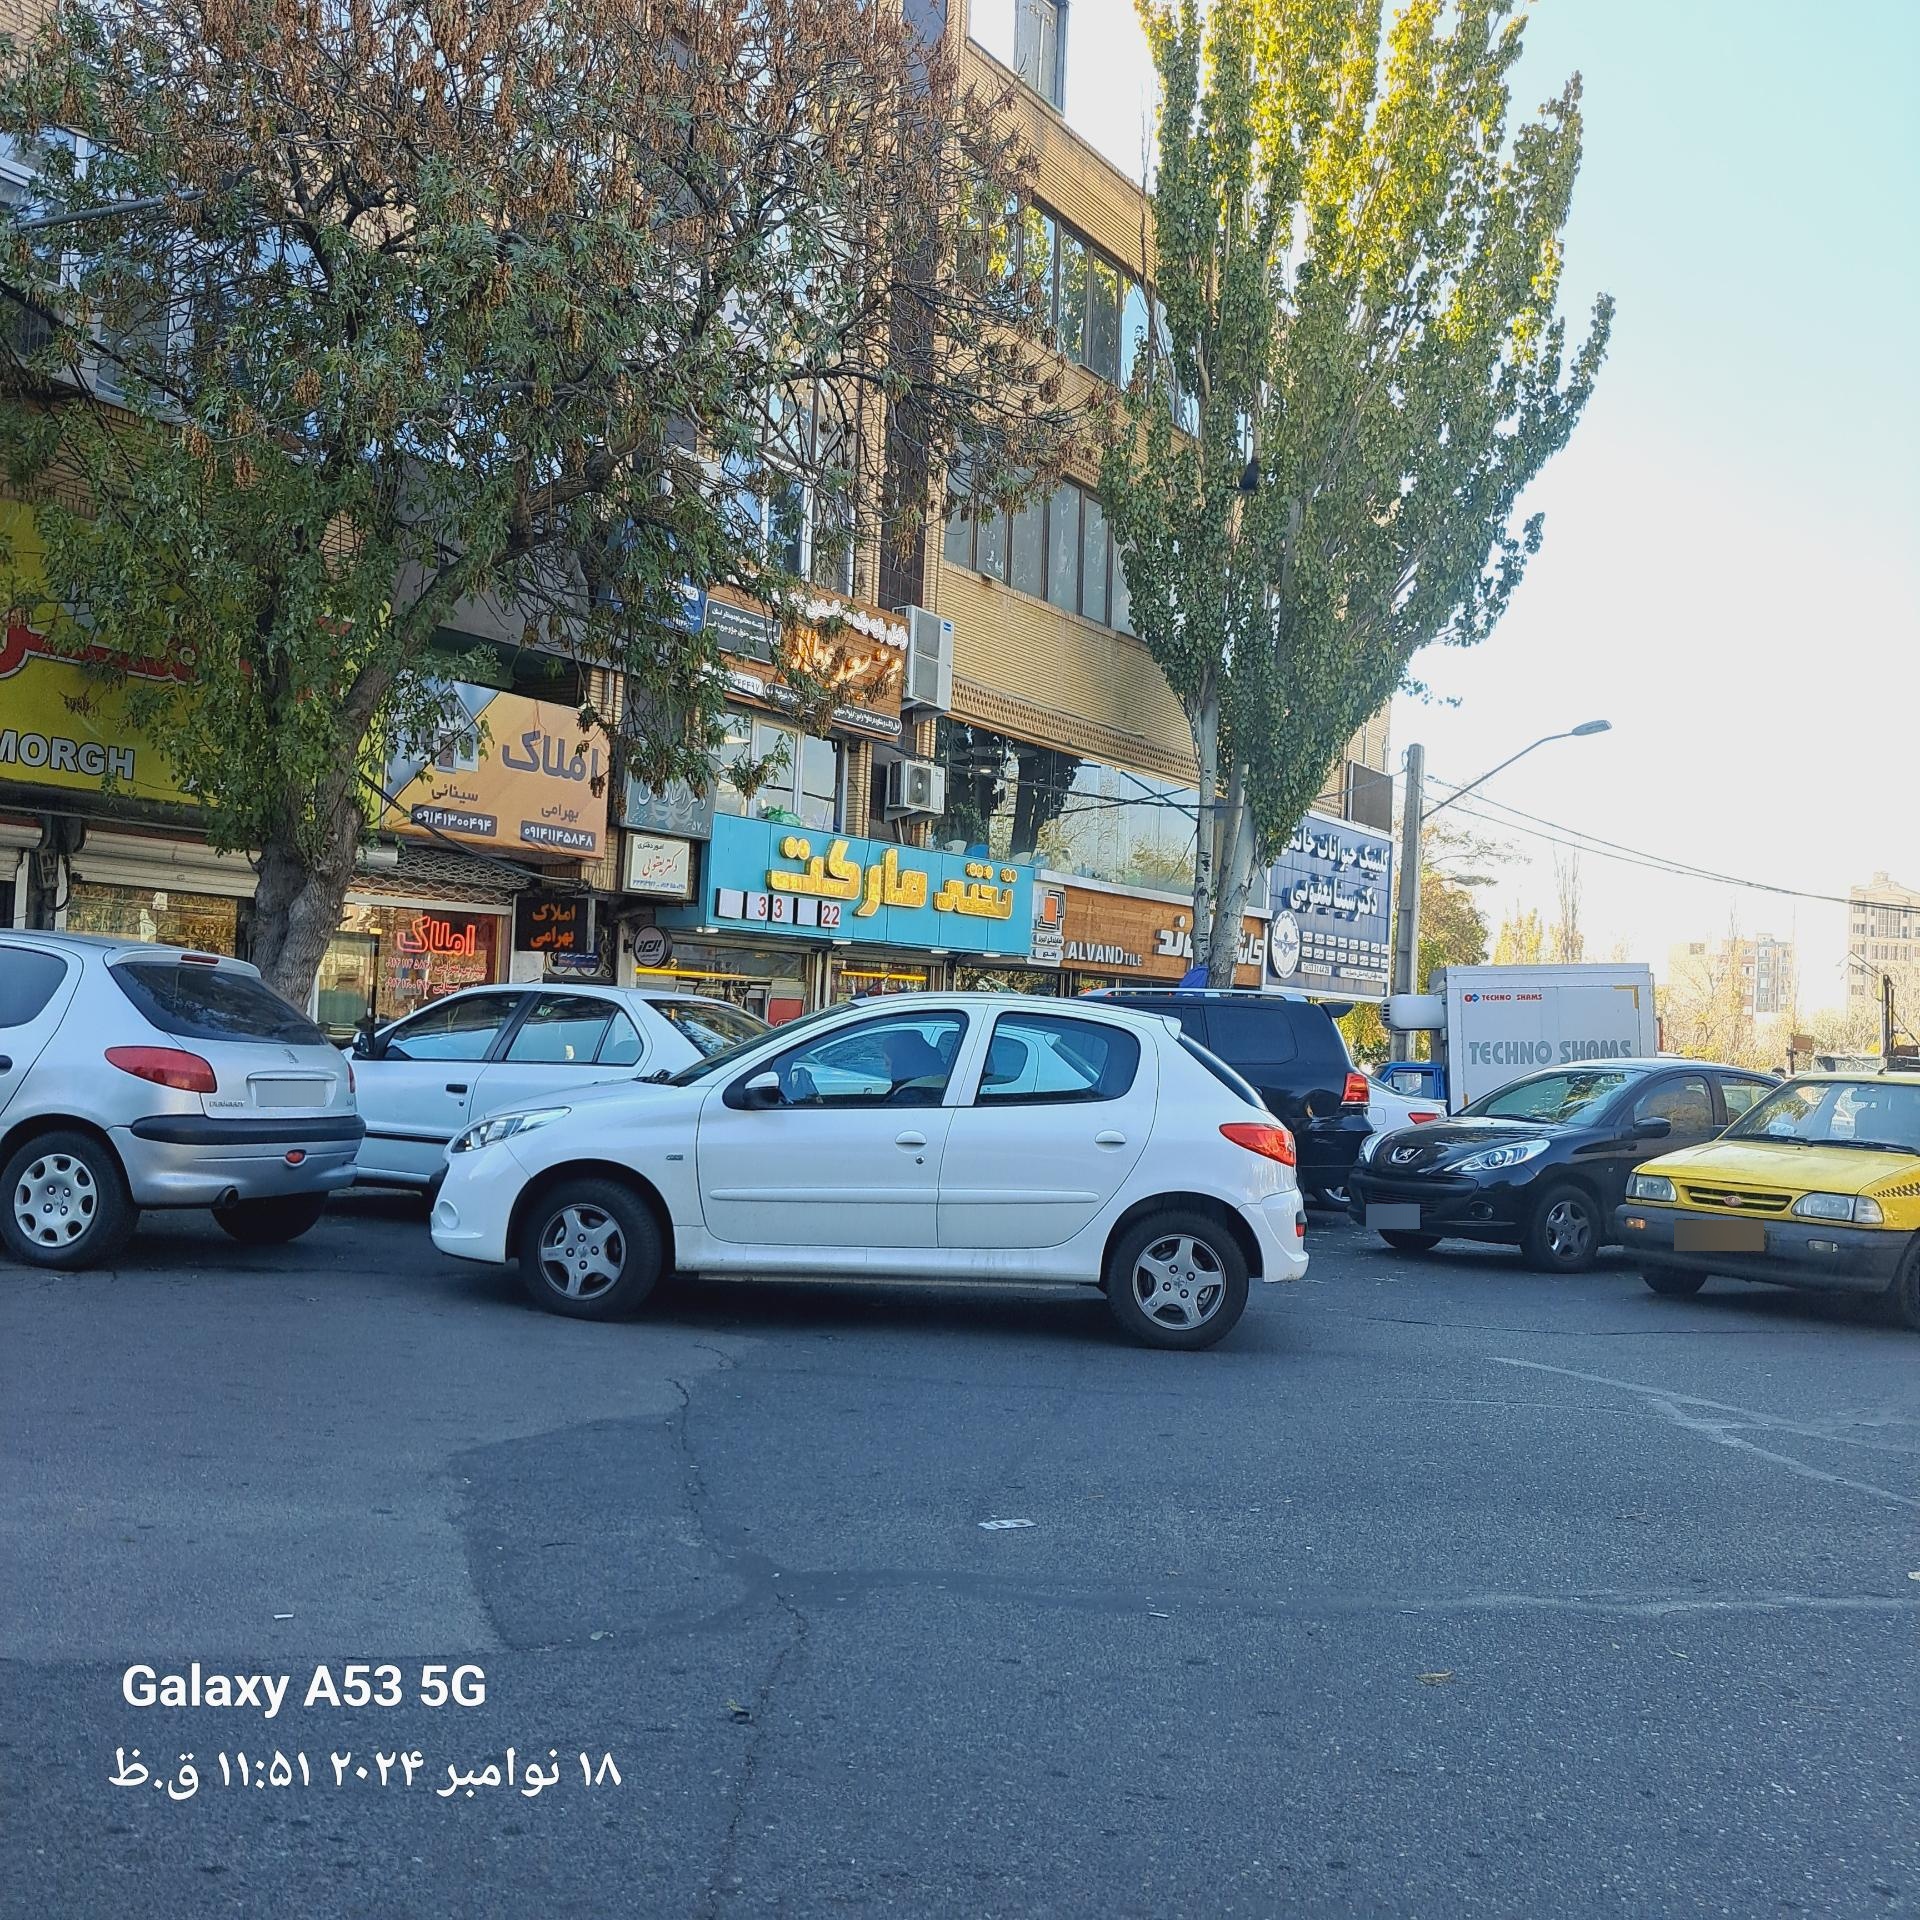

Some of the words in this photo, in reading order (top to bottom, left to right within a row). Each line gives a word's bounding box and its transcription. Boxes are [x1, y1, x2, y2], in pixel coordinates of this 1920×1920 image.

[502, 730, 600, 782] املاک
[416, 811, 493, 832] ۰۹۱۴۱۳۰۰۴۹۴
[541, 803, 580, 823] بهرامی
[524, 827, 594, 848] ۰۹۱۴۱۱۴۵۸۴۸
[659, 847, 684, 877] دکتر
[1318, 833, 1358, 872] حیوانات
[1358, 845, 1390, 880] کلینیک
[766, 836, 928, 917] مارکت
[1290, 876, 1333, 916] یعقوبی
[1334, 876, 1357, 919] سینا
[1353, 886, 1378, 922] دکتر
[532, 903, 577, 921] املاک
[822, 907, 840, 925] 22
[397, 915, 476, 957] املاک
[530, 925, 575, 949] بهرامی
[1067, 940, 1124, 965] ALVAND
[1124, 952, 1143, 967] TILE
[1481, 993, 1512, 1001] TECHNO
[1516, 993, 1543, 1001] SHAMS
[1468, 1040, 1553, 1065] TECHNO
[1559, 1039, 1632, 1064] SHAMS
